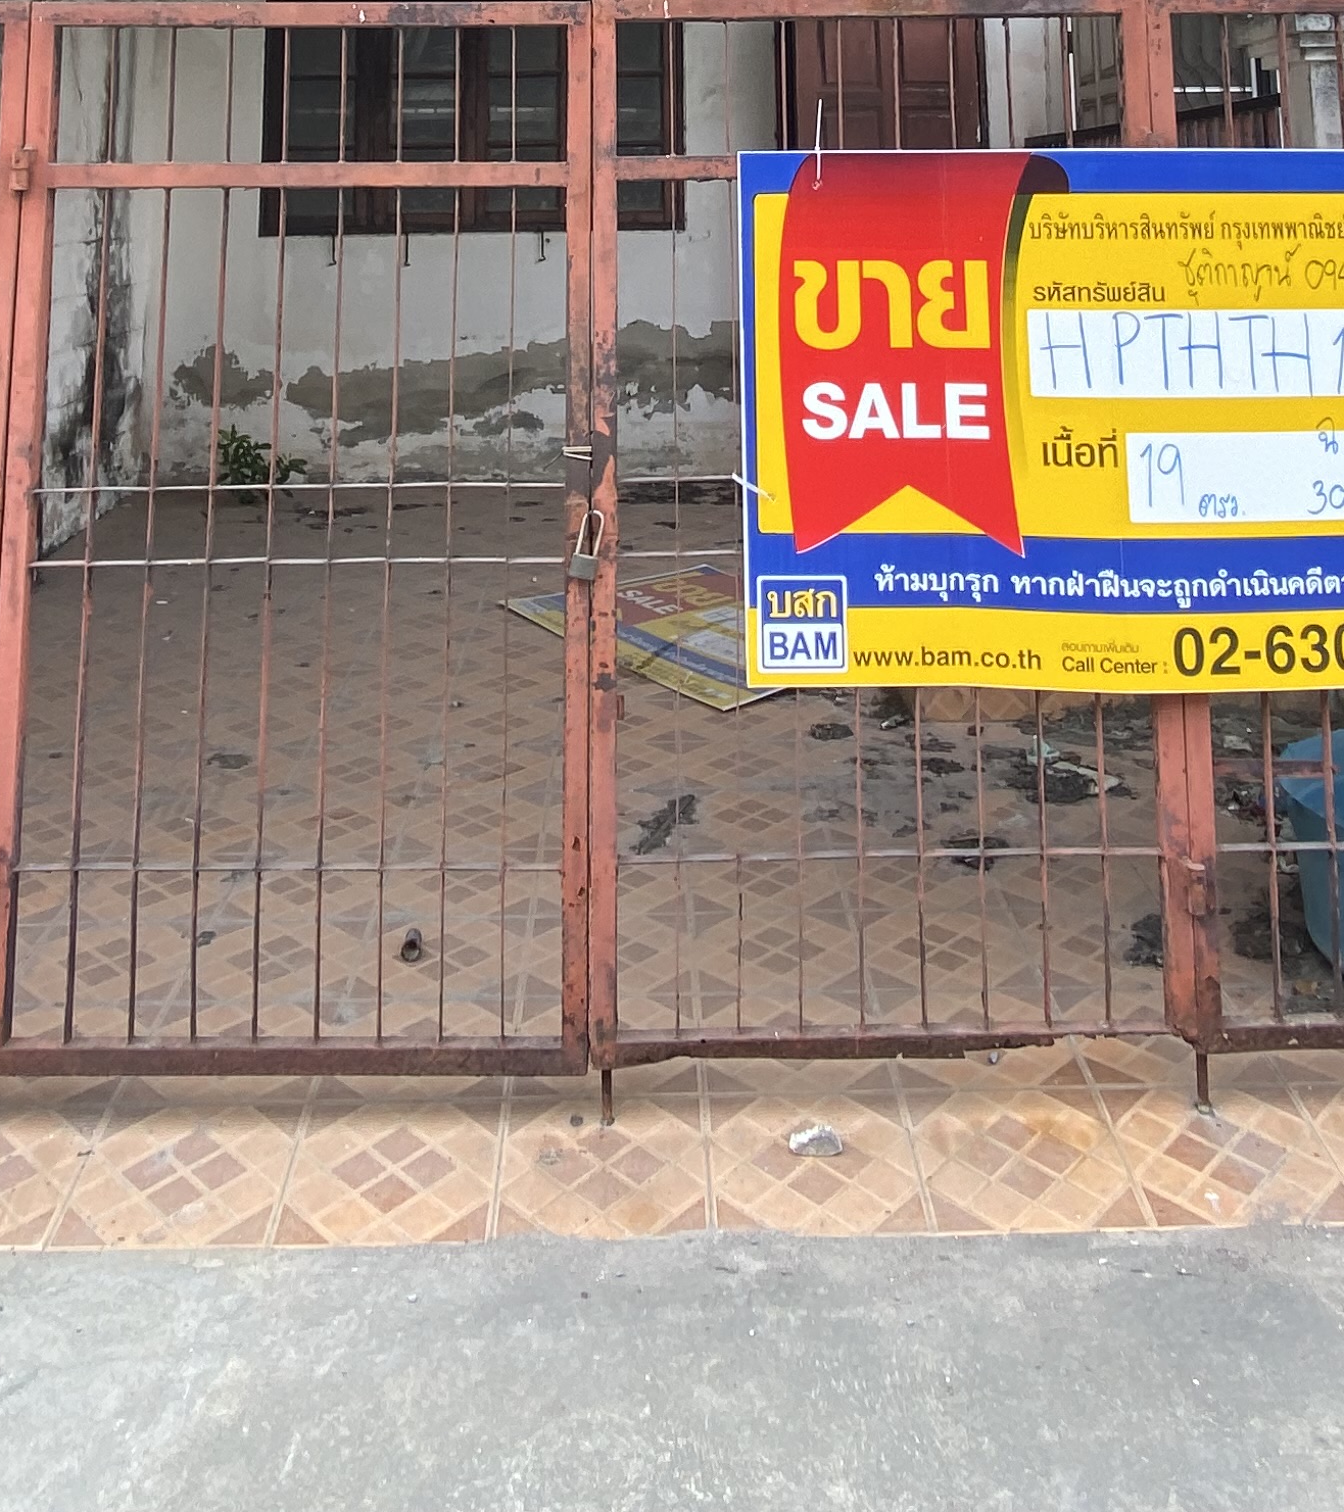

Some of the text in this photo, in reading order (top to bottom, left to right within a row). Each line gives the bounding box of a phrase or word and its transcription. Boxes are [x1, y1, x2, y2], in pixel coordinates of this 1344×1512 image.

[1029, 210, 1215, 239] บริษัทบริหารสินทรัพย์
[794, 259, 991, 350] ขาย
[1033, 281, 1166, 302] รหัสทรัพย์สิน
[802, 381, 990, 440] SALE
[1042, 426, 1119, 469] เนื้อที่
[1140, 443, 1184, 508] 19
[874, 564, 999, 602] ห้ามบุกรุก
[767, 589, 838, 619] บสก
[769, 631, 838, 660] BAM
[854, 646, 1042, 670] www.bam.co.th
[1062, 656, 1095, 673] Call
[1100, 657, 1157, 675] Center
